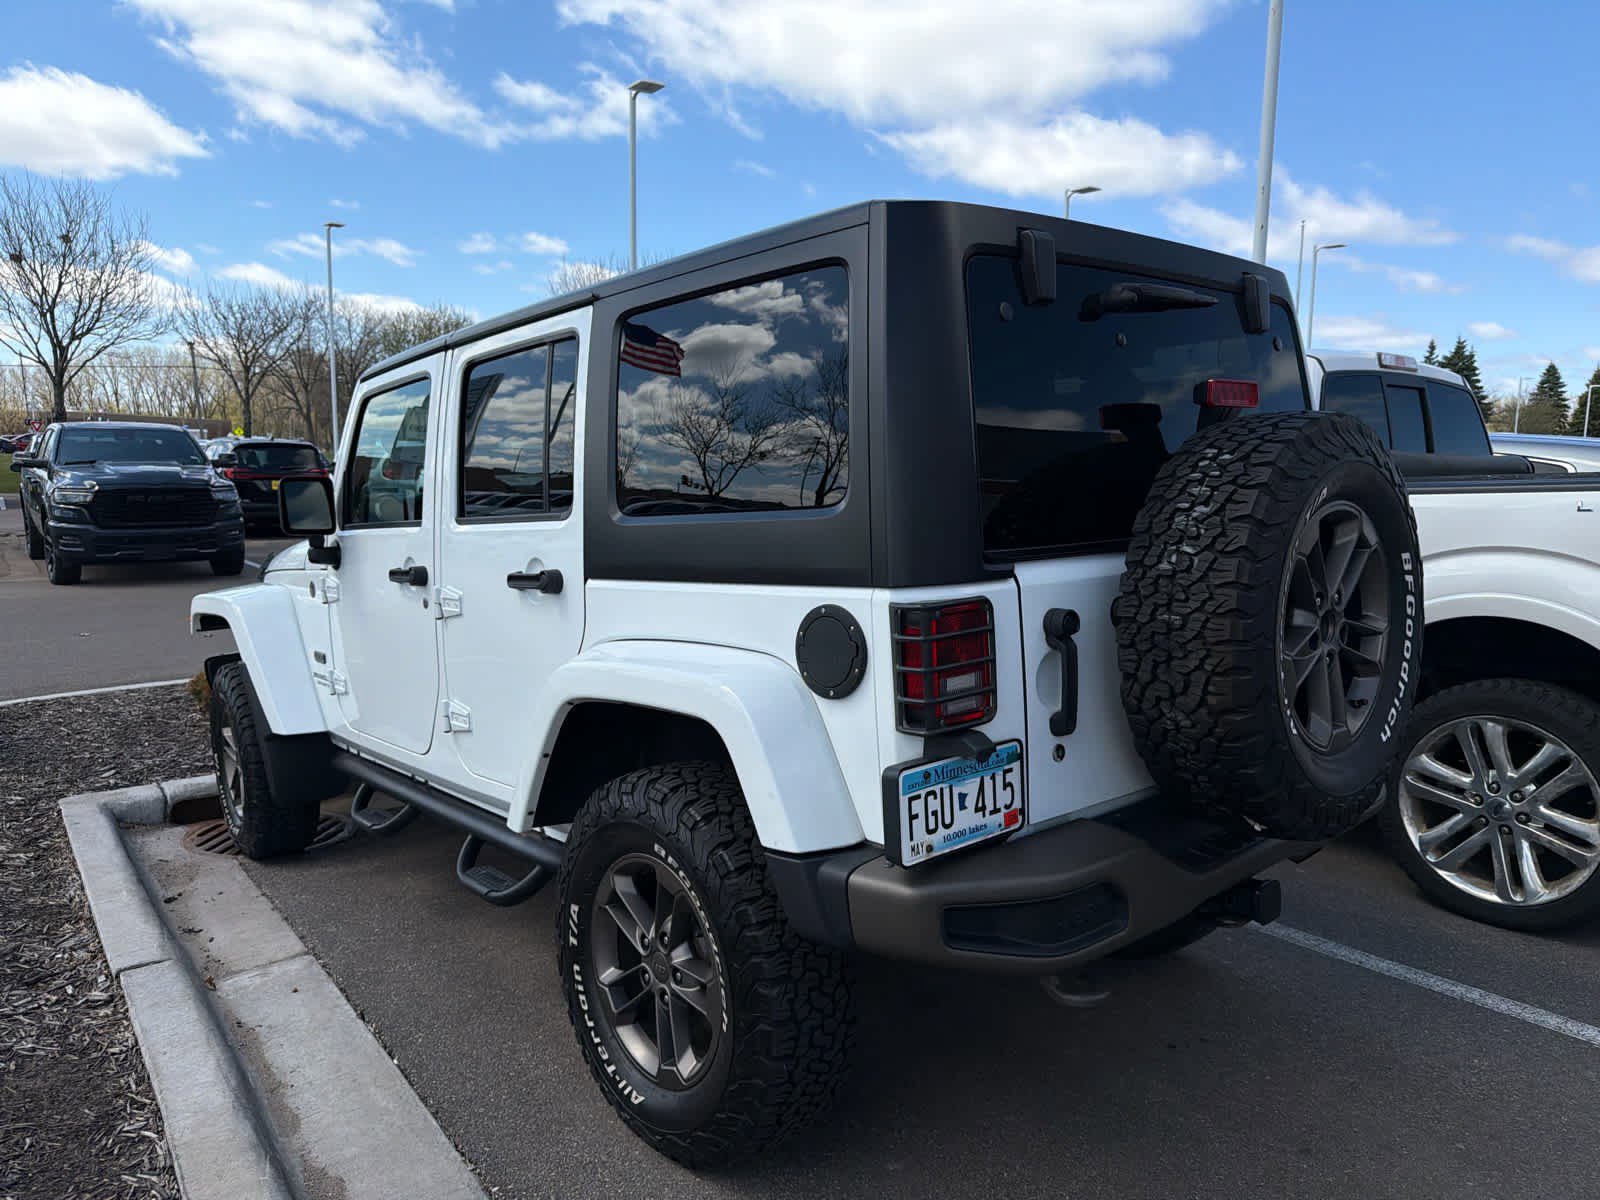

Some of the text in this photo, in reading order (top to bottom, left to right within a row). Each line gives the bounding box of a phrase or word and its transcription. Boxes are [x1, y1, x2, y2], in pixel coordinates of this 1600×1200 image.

[1380, 552, 1416, 744] BFGoodrich
[908, 767, 1015, 842] FGU 415
[911, 840, 924, 857] MAY
[568, 903, 580, 947] T/A
